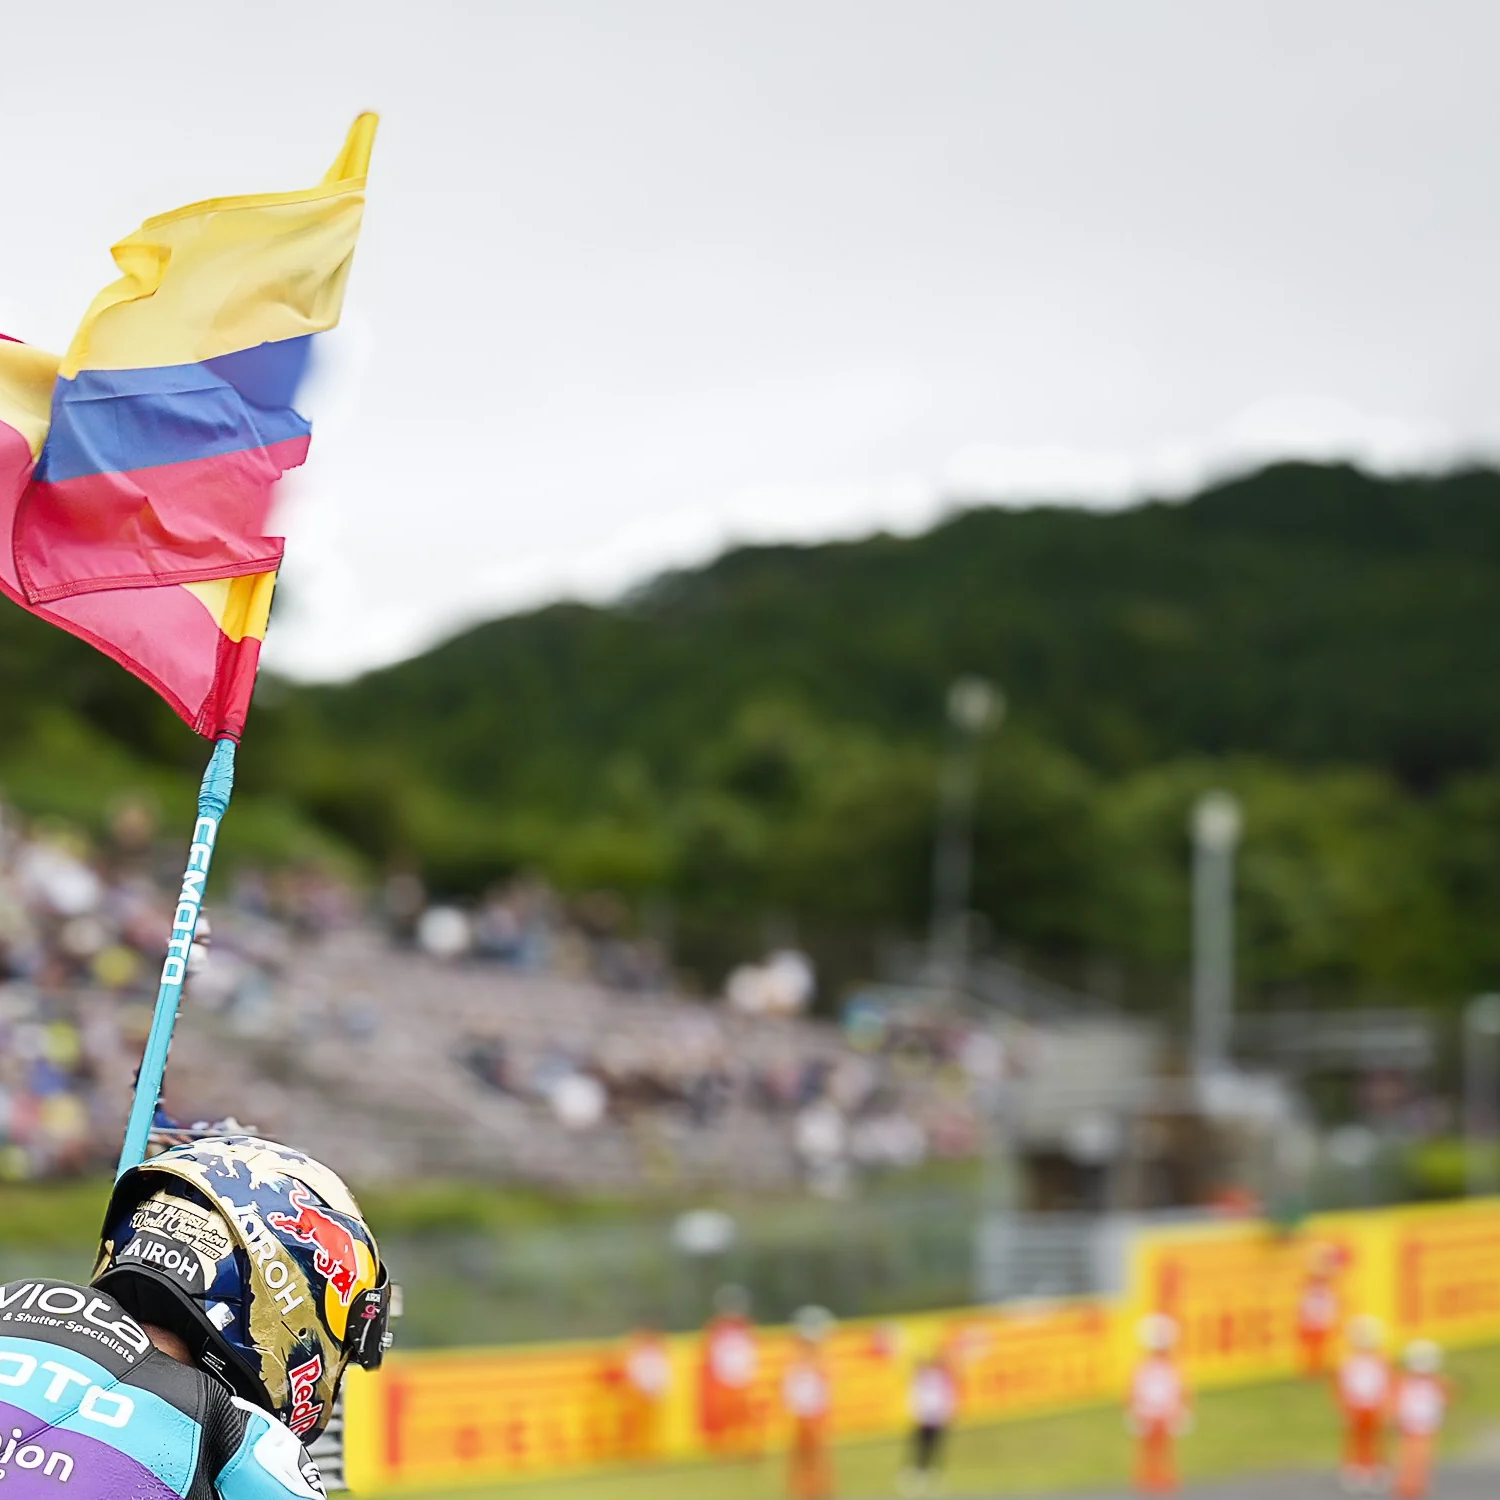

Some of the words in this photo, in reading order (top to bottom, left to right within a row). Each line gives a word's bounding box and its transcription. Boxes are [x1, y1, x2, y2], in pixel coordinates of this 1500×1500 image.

[160, 817, 217, 985] CFMOTO
[132, 1210, 168, 1230] World
[124, 1238, 199, 1282] AIROH
[3, 1311, 12, 1322] &
[14, 1313, 64, 1328] Shutter
[64, 1320, 135, 1364] Specialists
